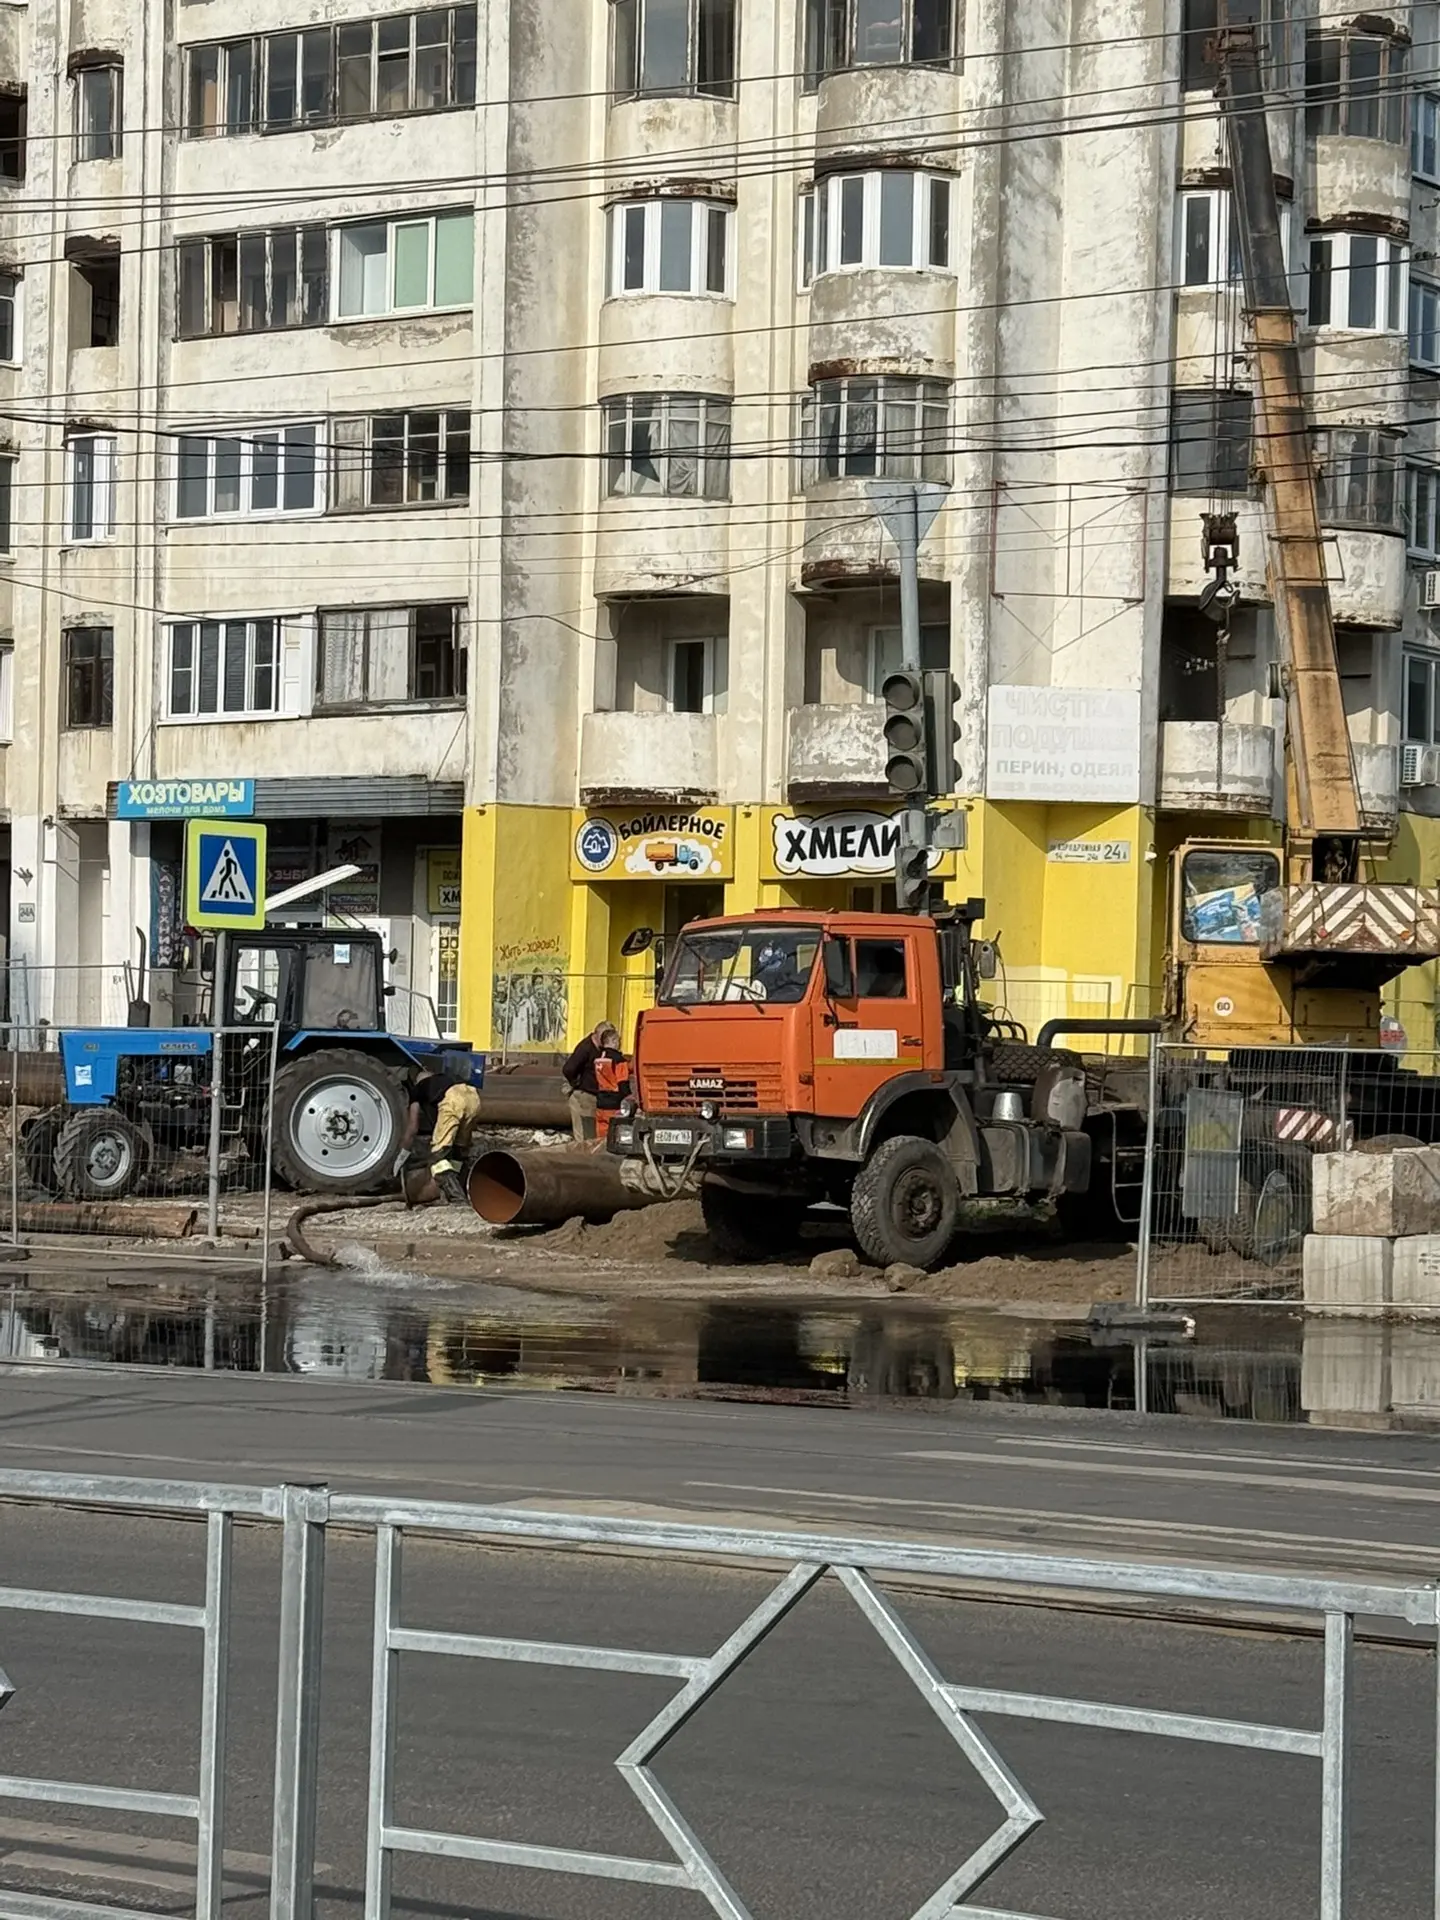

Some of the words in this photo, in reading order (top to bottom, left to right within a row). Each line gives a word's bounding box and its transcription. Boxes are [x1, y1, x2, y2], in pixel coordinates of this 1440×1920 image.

[992, 723, 1133, 754] ПОДУШ
[127, 781, 245, 805] ХОЗТОВАРЫ
[183, 806, 200, 815] для
[203, 805, 226, 814] дома
[618, 812, 725, 841] БОЙЛЕРНОЕ
[785, 824, 901, 862] ХМЕЛИ
[158, 864, 172, 966] САНТЕХНИКА
[1216, 1001, 1231, 1011] 60
[689, 1079, 724, 1089] KAMAZ
